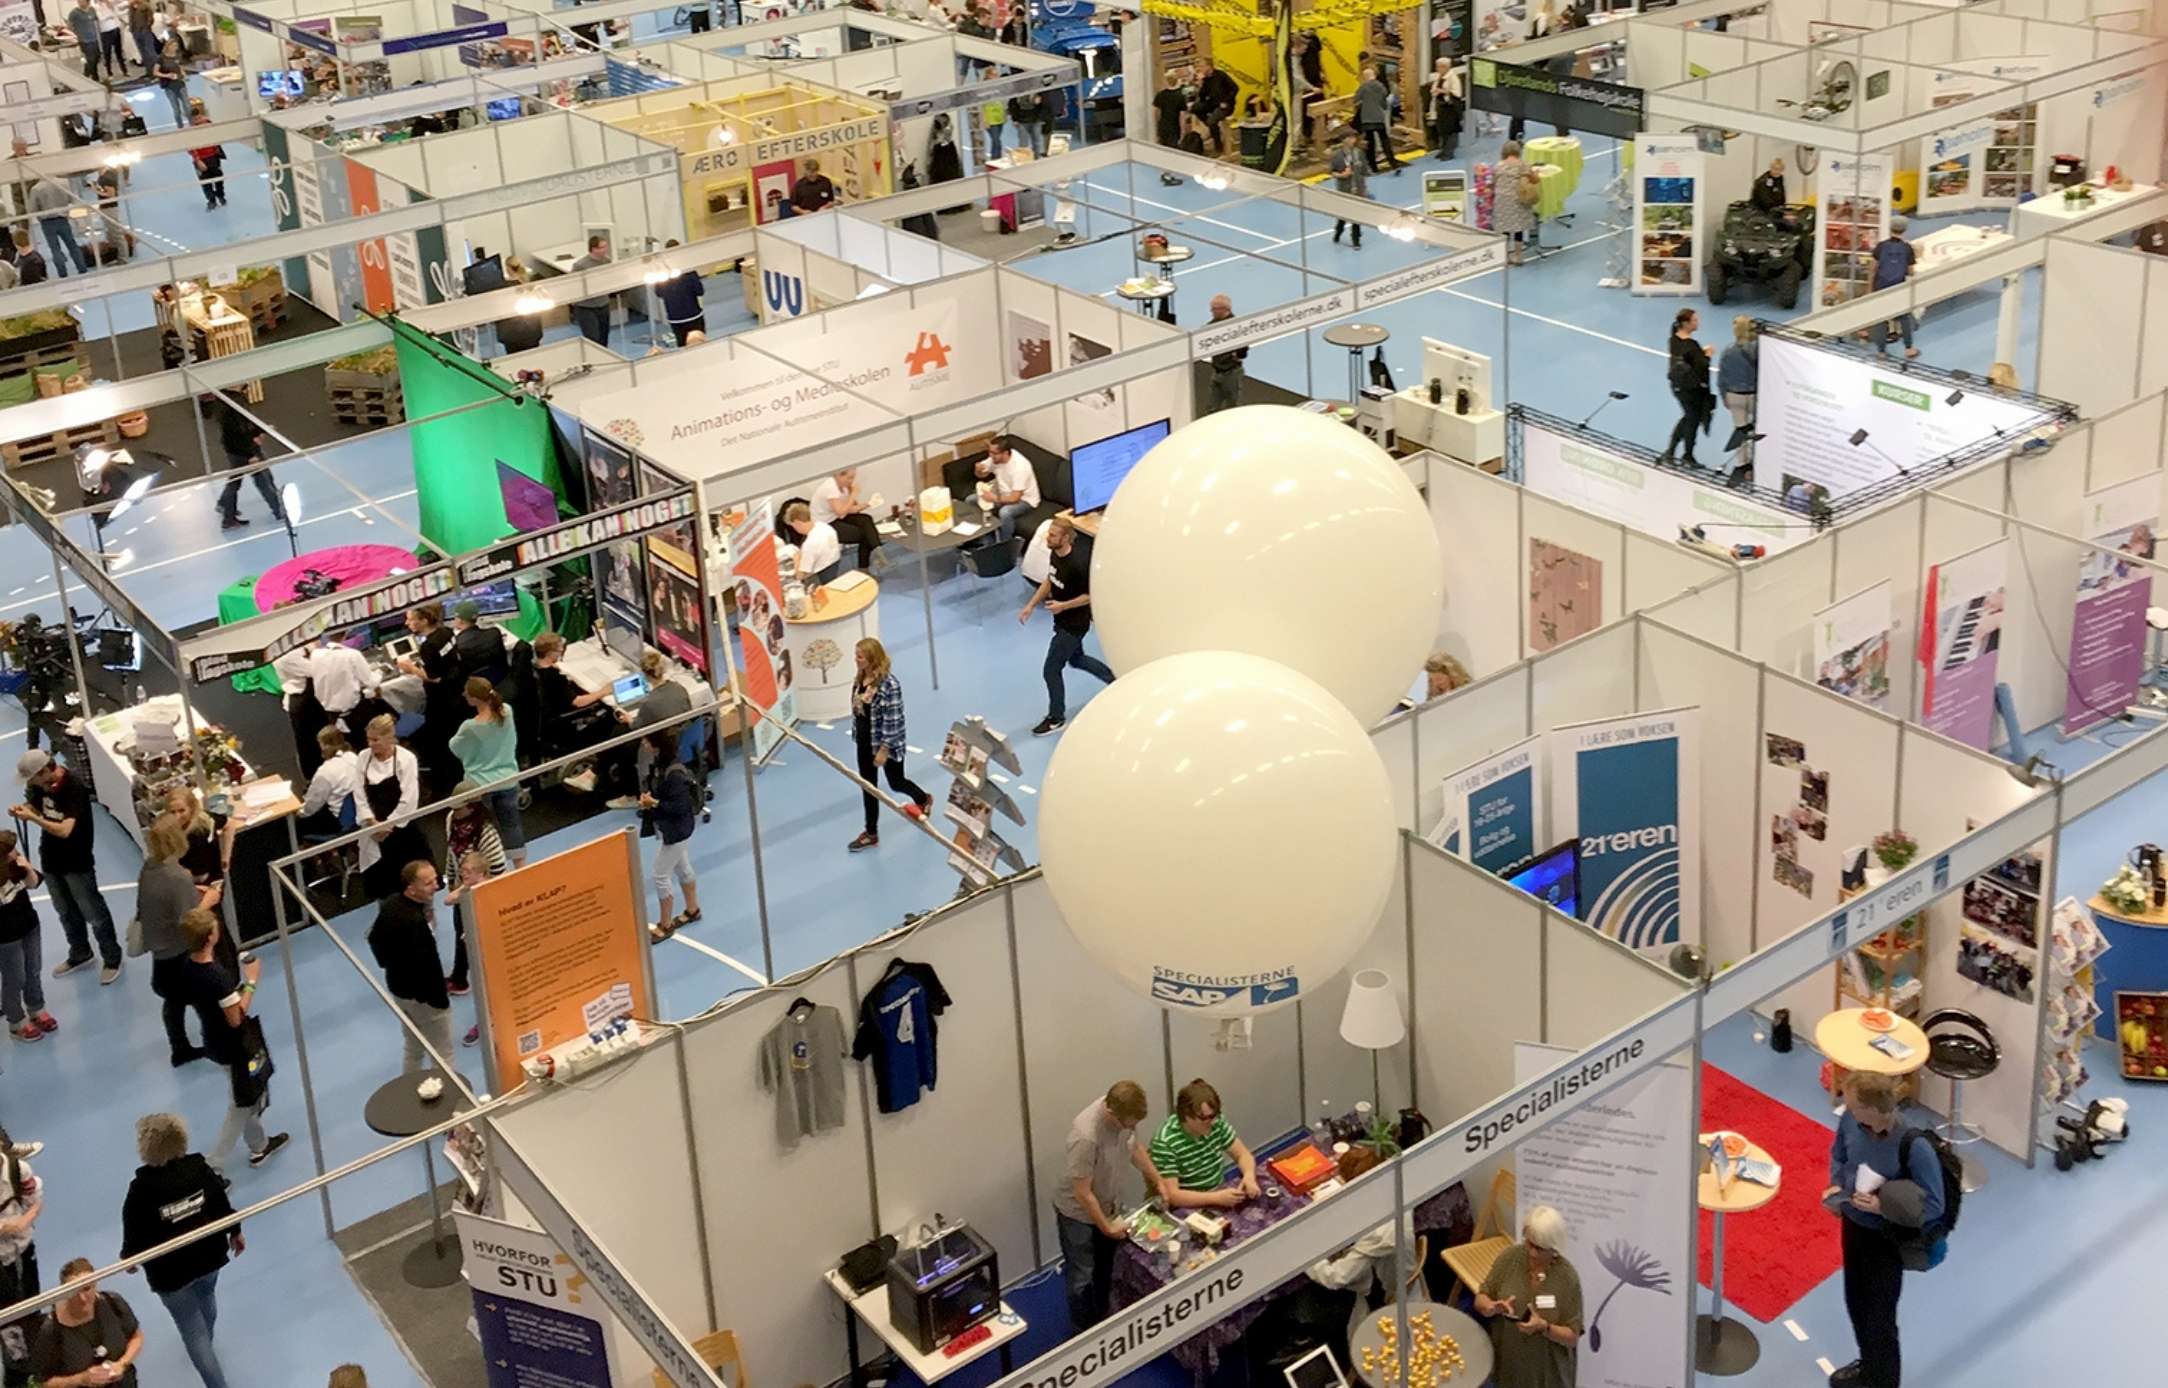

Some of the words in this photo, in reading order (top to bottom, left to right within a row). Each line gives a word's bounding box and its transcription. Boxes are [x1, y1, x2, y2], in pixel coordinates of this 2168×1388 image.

[757, 119, 881, 162] EFTERSKOLE
[763, 269, 803, 317] UU
[1363, 246, 1496, 301] specialefterskolerne.dk
[1197, 295, 1343, 350] specialefterskolerne.dk
[670, 402, 769, 441] Animations-
[770, 395, 793, 412] og
[575, 511, 622, 548] KAN
[623, 493, 695, 538] NOGET
[372, 568, 455, 615] NOGET
[1614, 727, 1635, 743] SOM
[1153, 964, 1297, 986] SPECIALISTERNE
[1153, 980, 1228, 1006] SAP
[1464, 1037, 1645, 1154] Specialisterne
[471, 1238, 552, 1269] HVORFOR
[496, 1265, 558, 1298] STU
[1018, 1267, 1245, 1388] pecialisterne
